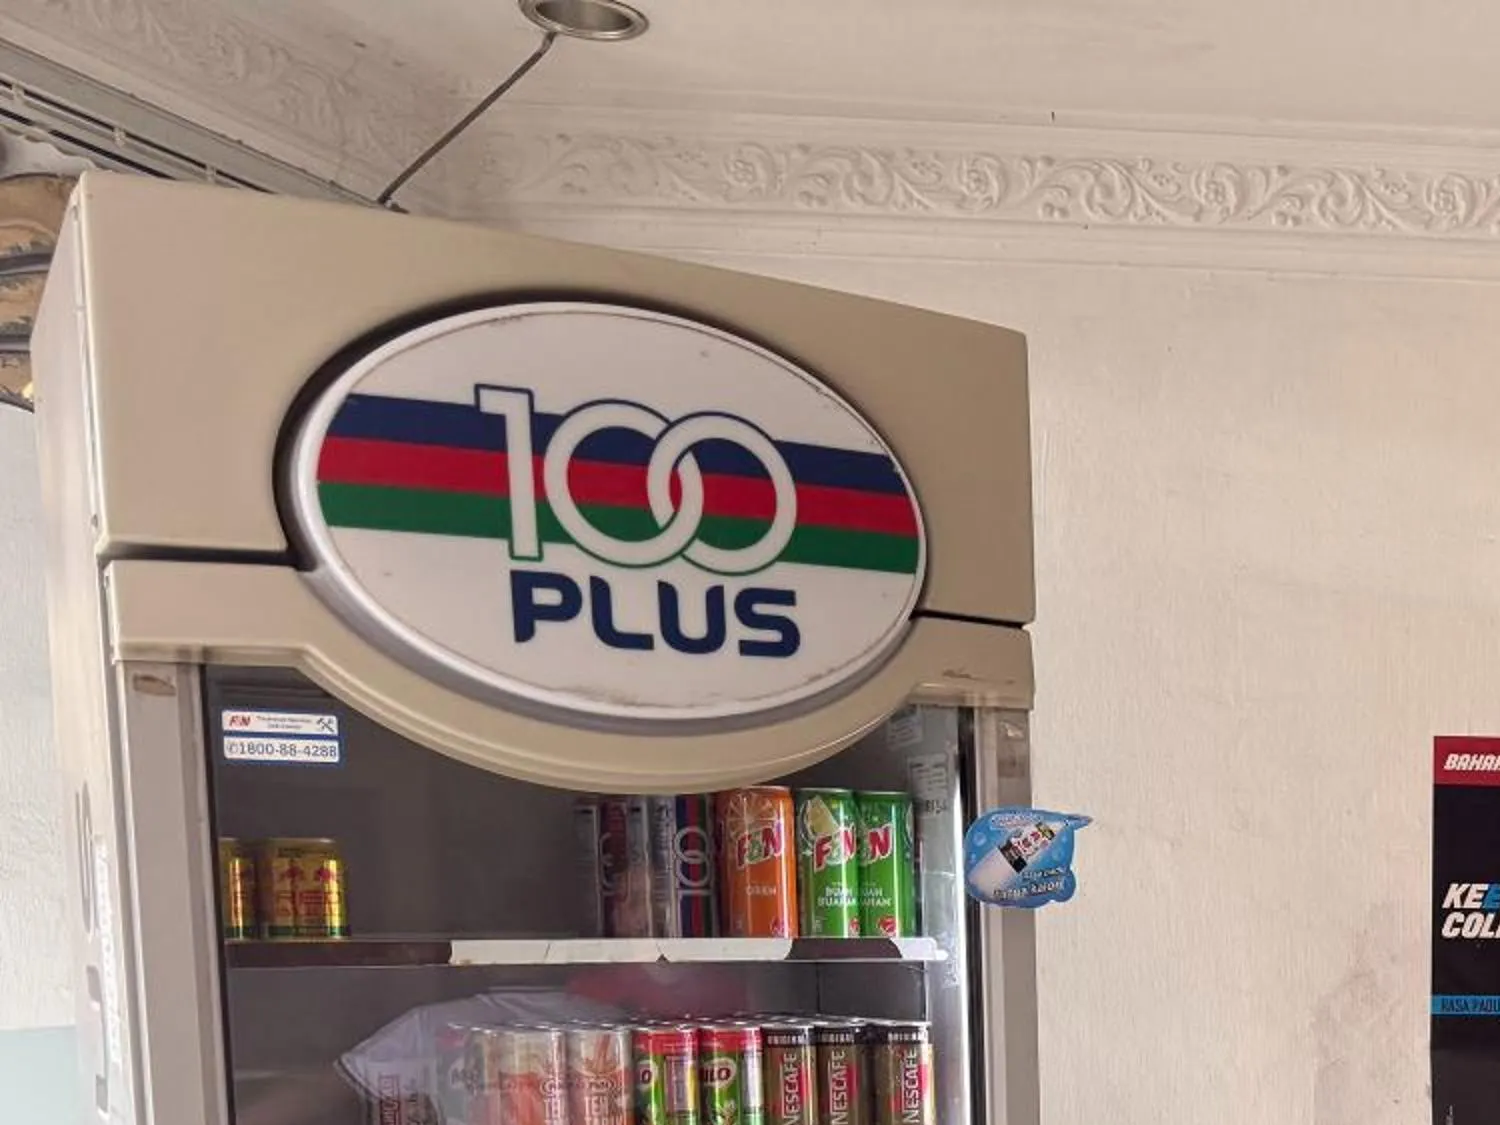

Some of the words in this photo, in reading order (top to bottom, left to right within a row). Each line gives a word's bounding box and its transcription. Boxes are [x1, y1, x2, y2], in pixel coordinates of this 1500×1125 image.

[474, 384, 797, 576] 100
[510, 569, 800, 658] PLUS
[239, 743, 337, 757] 1800-88-4288
[1441, 998, 1469, 1012] RASA
